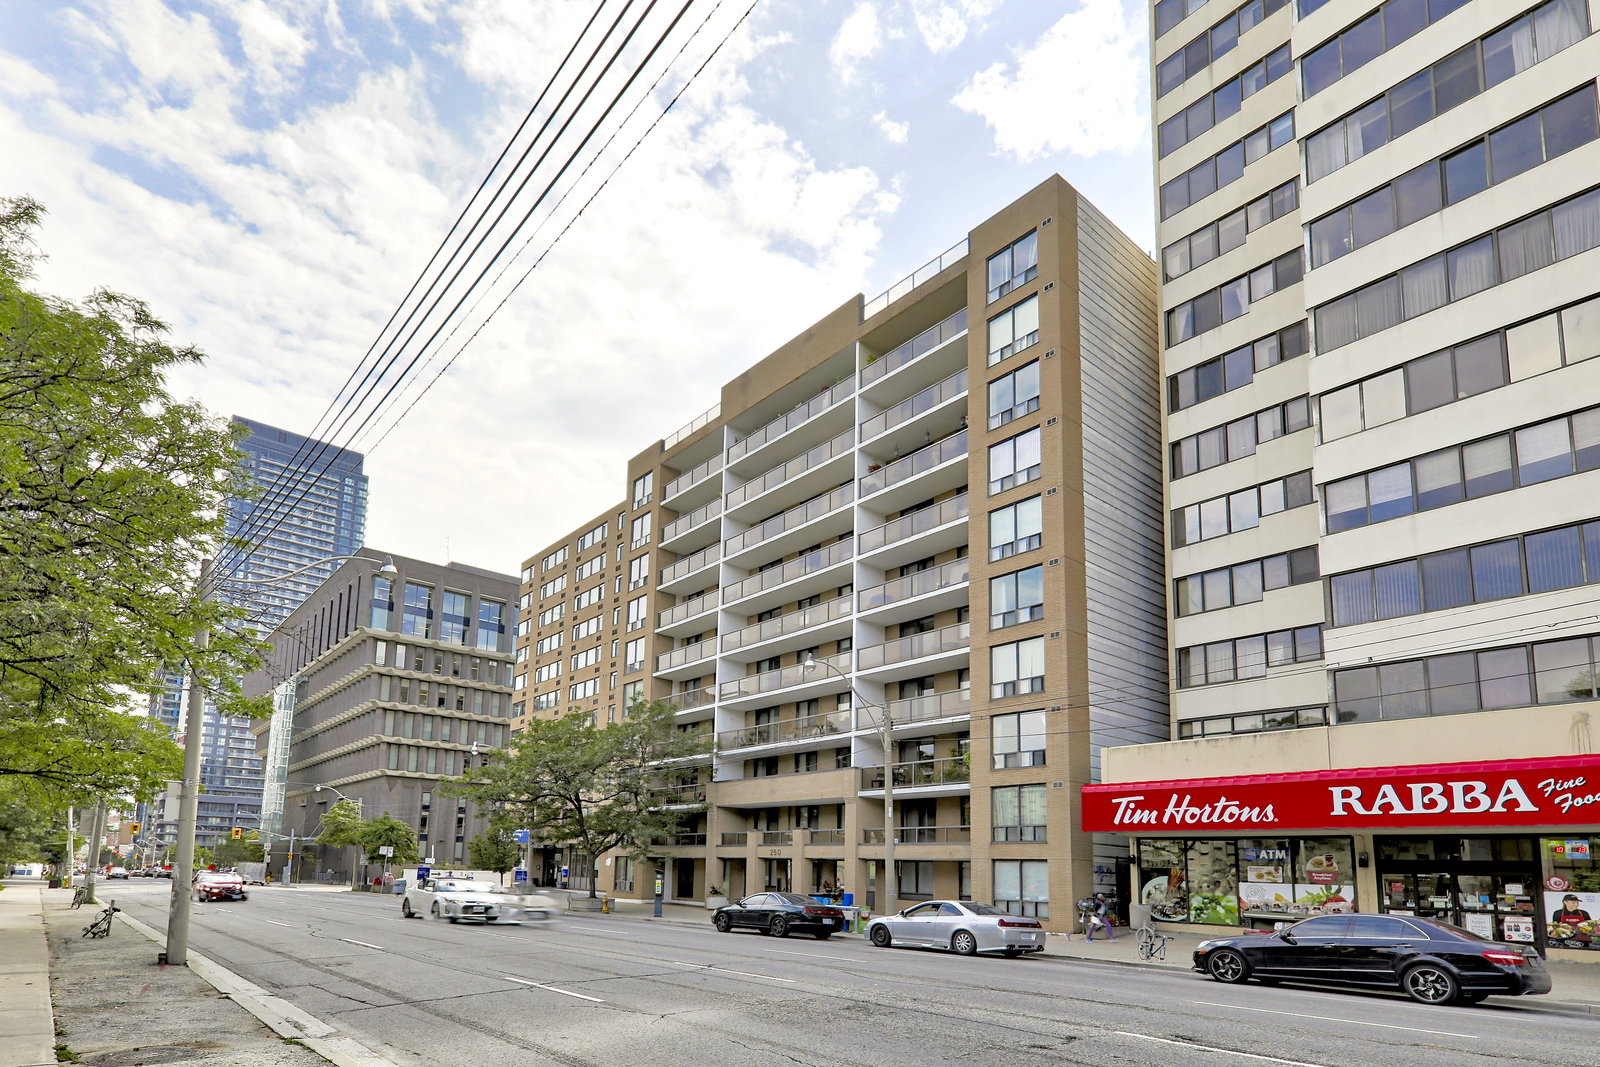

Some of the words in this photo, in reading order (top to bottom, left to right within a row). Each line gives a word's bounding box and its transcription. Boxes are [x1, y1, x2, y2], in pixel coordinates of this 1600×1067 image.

[1328, 778, 1540, 816] RABBA
[1537, 776, 1587, 798] Fine
[1111, 795, 1158, 825] Tim
[1162, 793, 1275, 825] Hortons
[769, 848, 782, 856] 250
[1259, 849, 1287, 859] ATM
